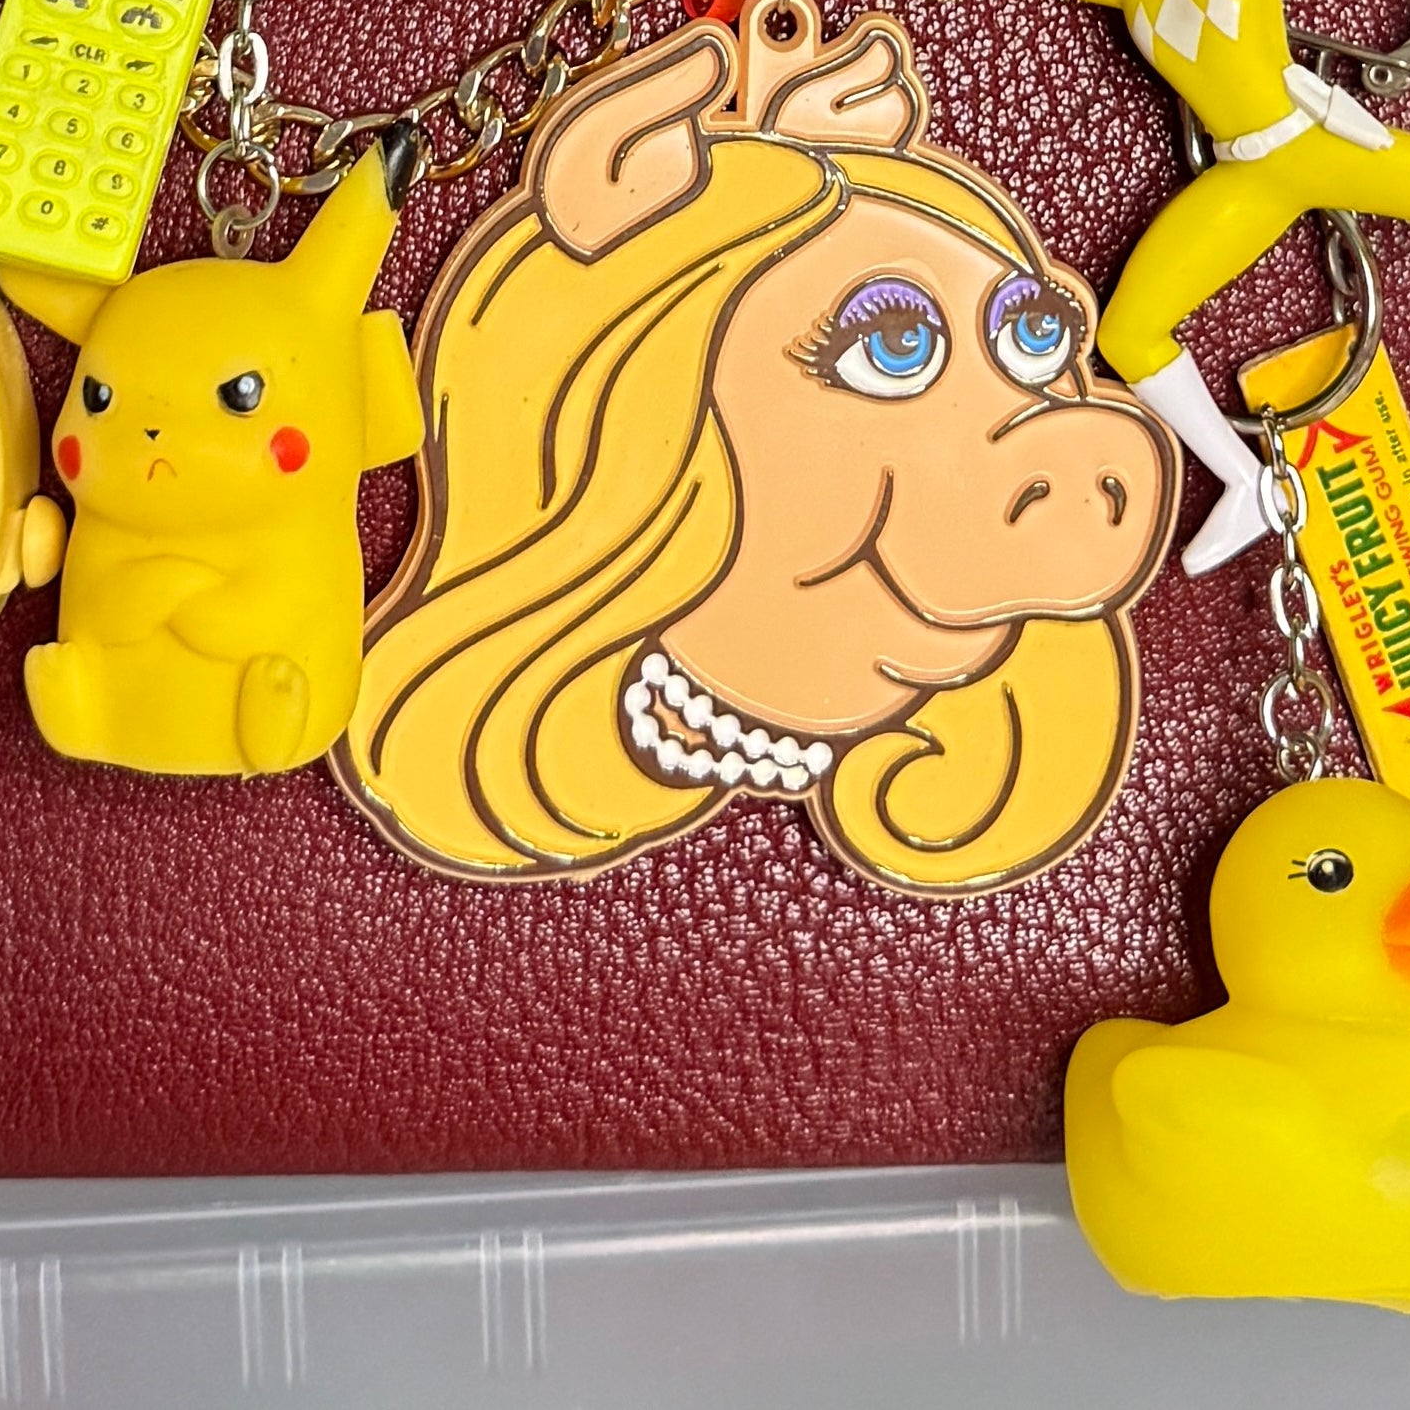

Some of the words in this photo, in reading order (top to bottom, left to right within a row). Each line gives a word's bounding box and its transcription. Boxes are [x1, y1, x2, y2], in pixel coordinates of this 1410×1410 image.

[74, 43, 107, 62] CLR
[1374, 390, 1392, 424] use.
[1385, 428, 1408, 463] after
[1360, 444, 1393, 501] GUM
[1316, 458, 1395, 580] FRUIT
[1328, 559, 1394, 696] WRIGLEY'S
